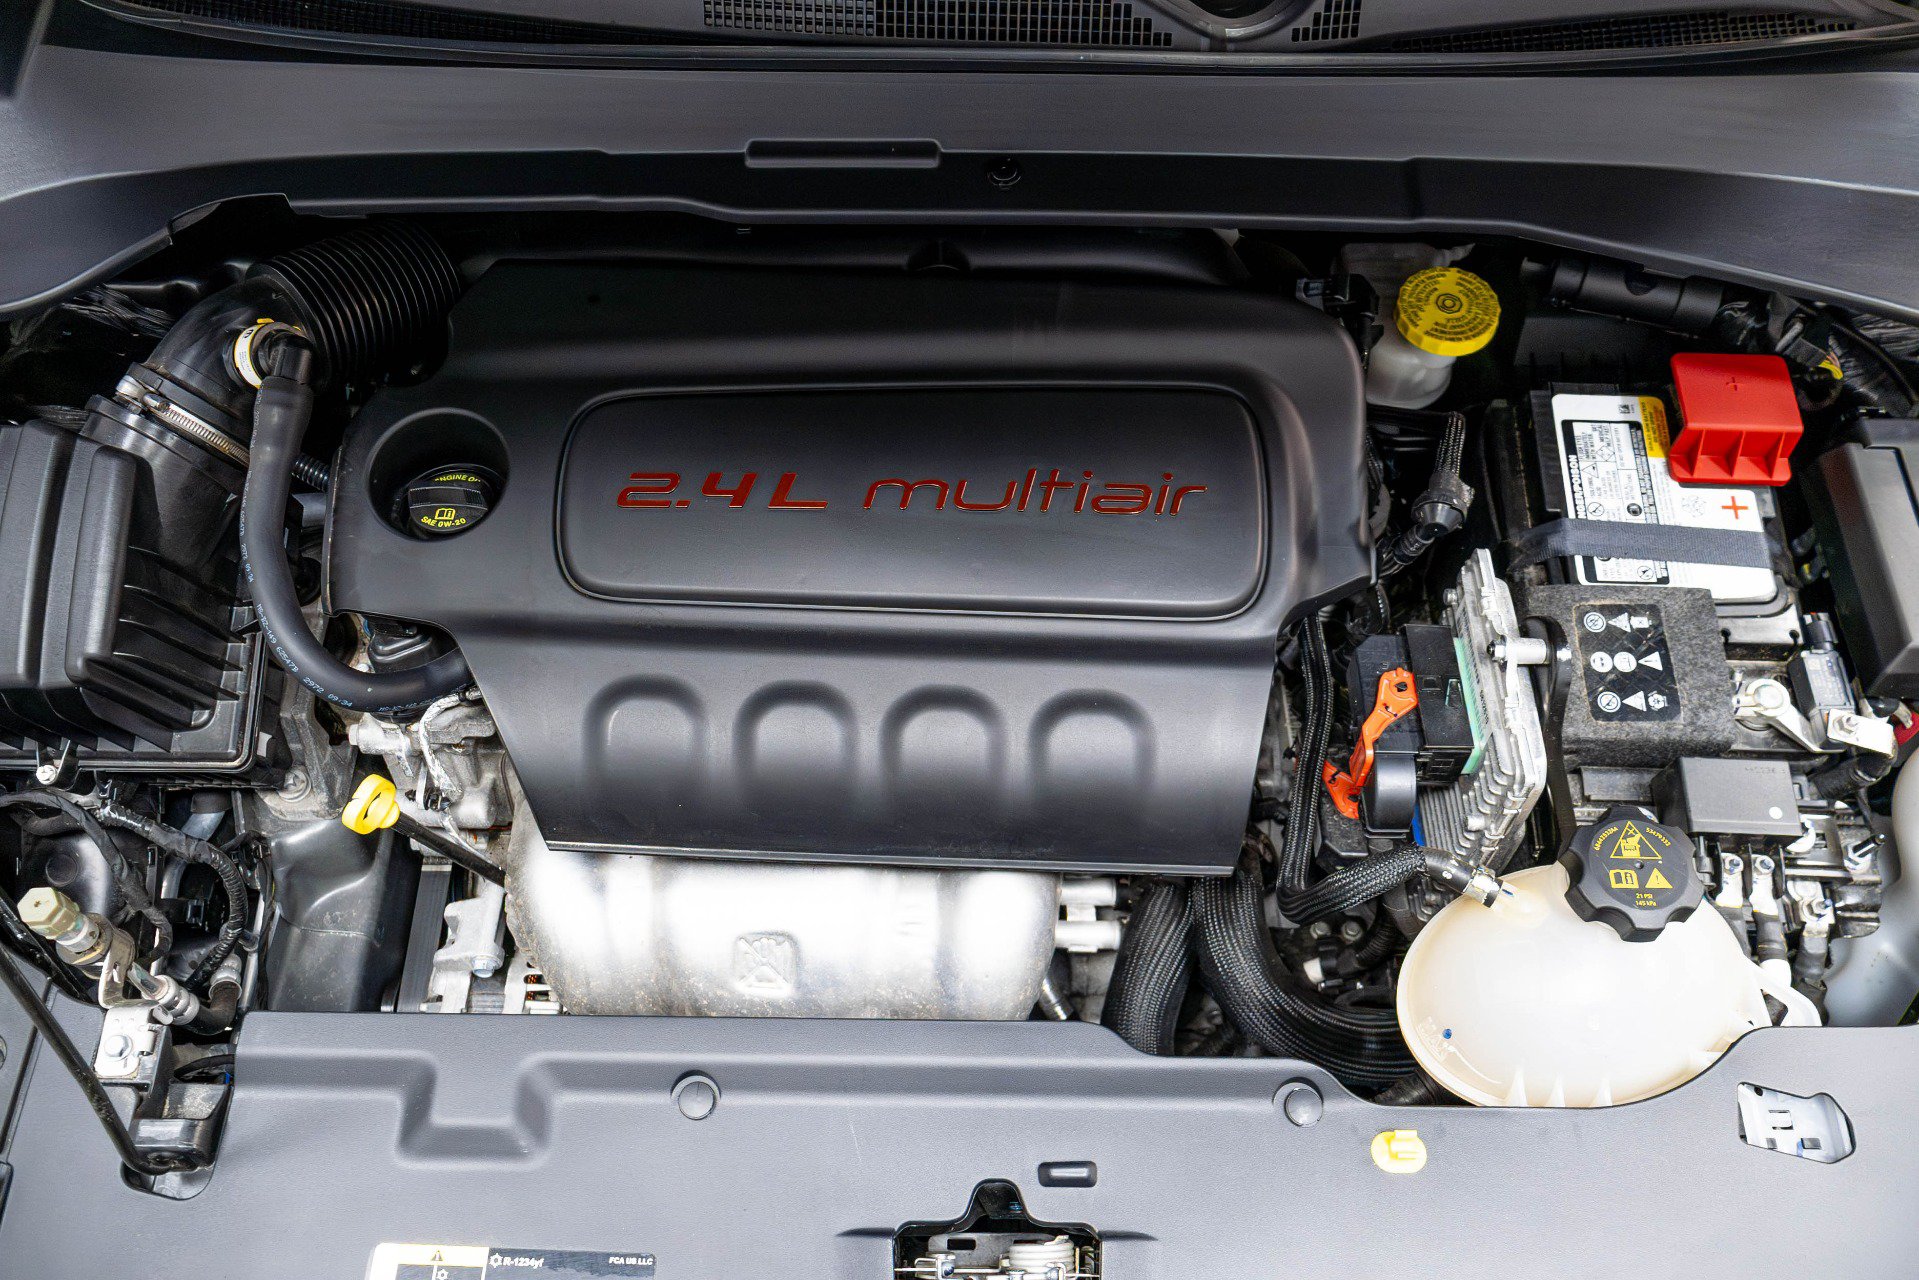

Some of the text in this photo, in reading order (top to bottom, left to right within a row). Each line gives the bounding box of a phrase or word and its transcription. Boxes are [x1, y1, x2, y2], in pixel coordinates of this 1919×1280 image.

[862, 467, 1208, 516] multiair
[1568, 454, 1587, 519] NGER/POISON
[421, 516, 467, 528] SAE 0W-20
[502, 1256, 545, 1269] R-1234yf
[608, 1256, 654, 1266] FCA US LLC
